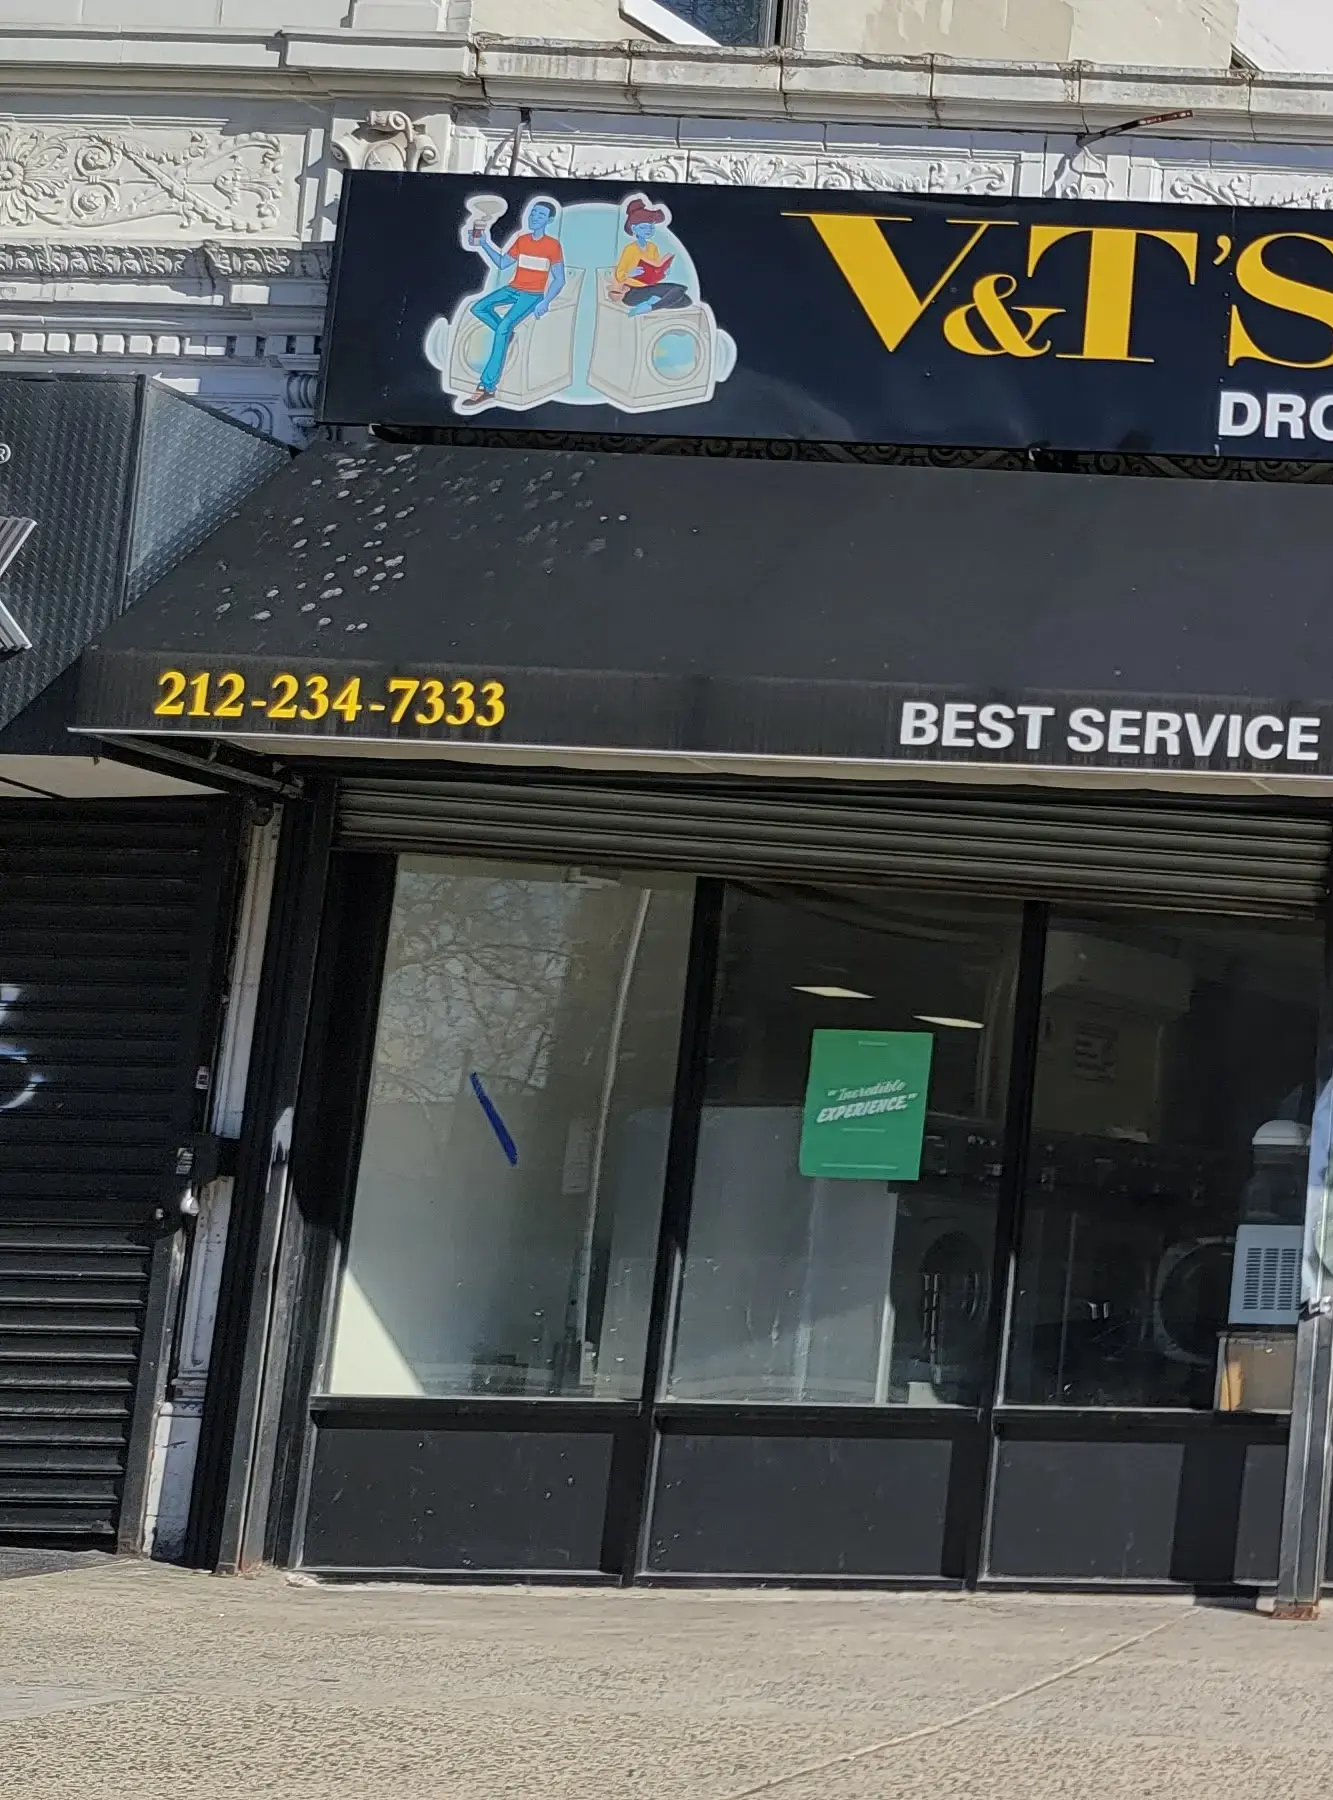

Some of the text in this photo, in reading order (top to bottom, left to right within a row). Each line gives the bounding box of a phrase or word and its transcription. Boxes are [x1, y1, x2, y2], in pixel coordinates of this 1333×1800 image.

[153, 670, 506, 728] 212-234-7333
[899, 701, 1056, 751] BEST
[1066, 707, 1321, 761] SERVICE
